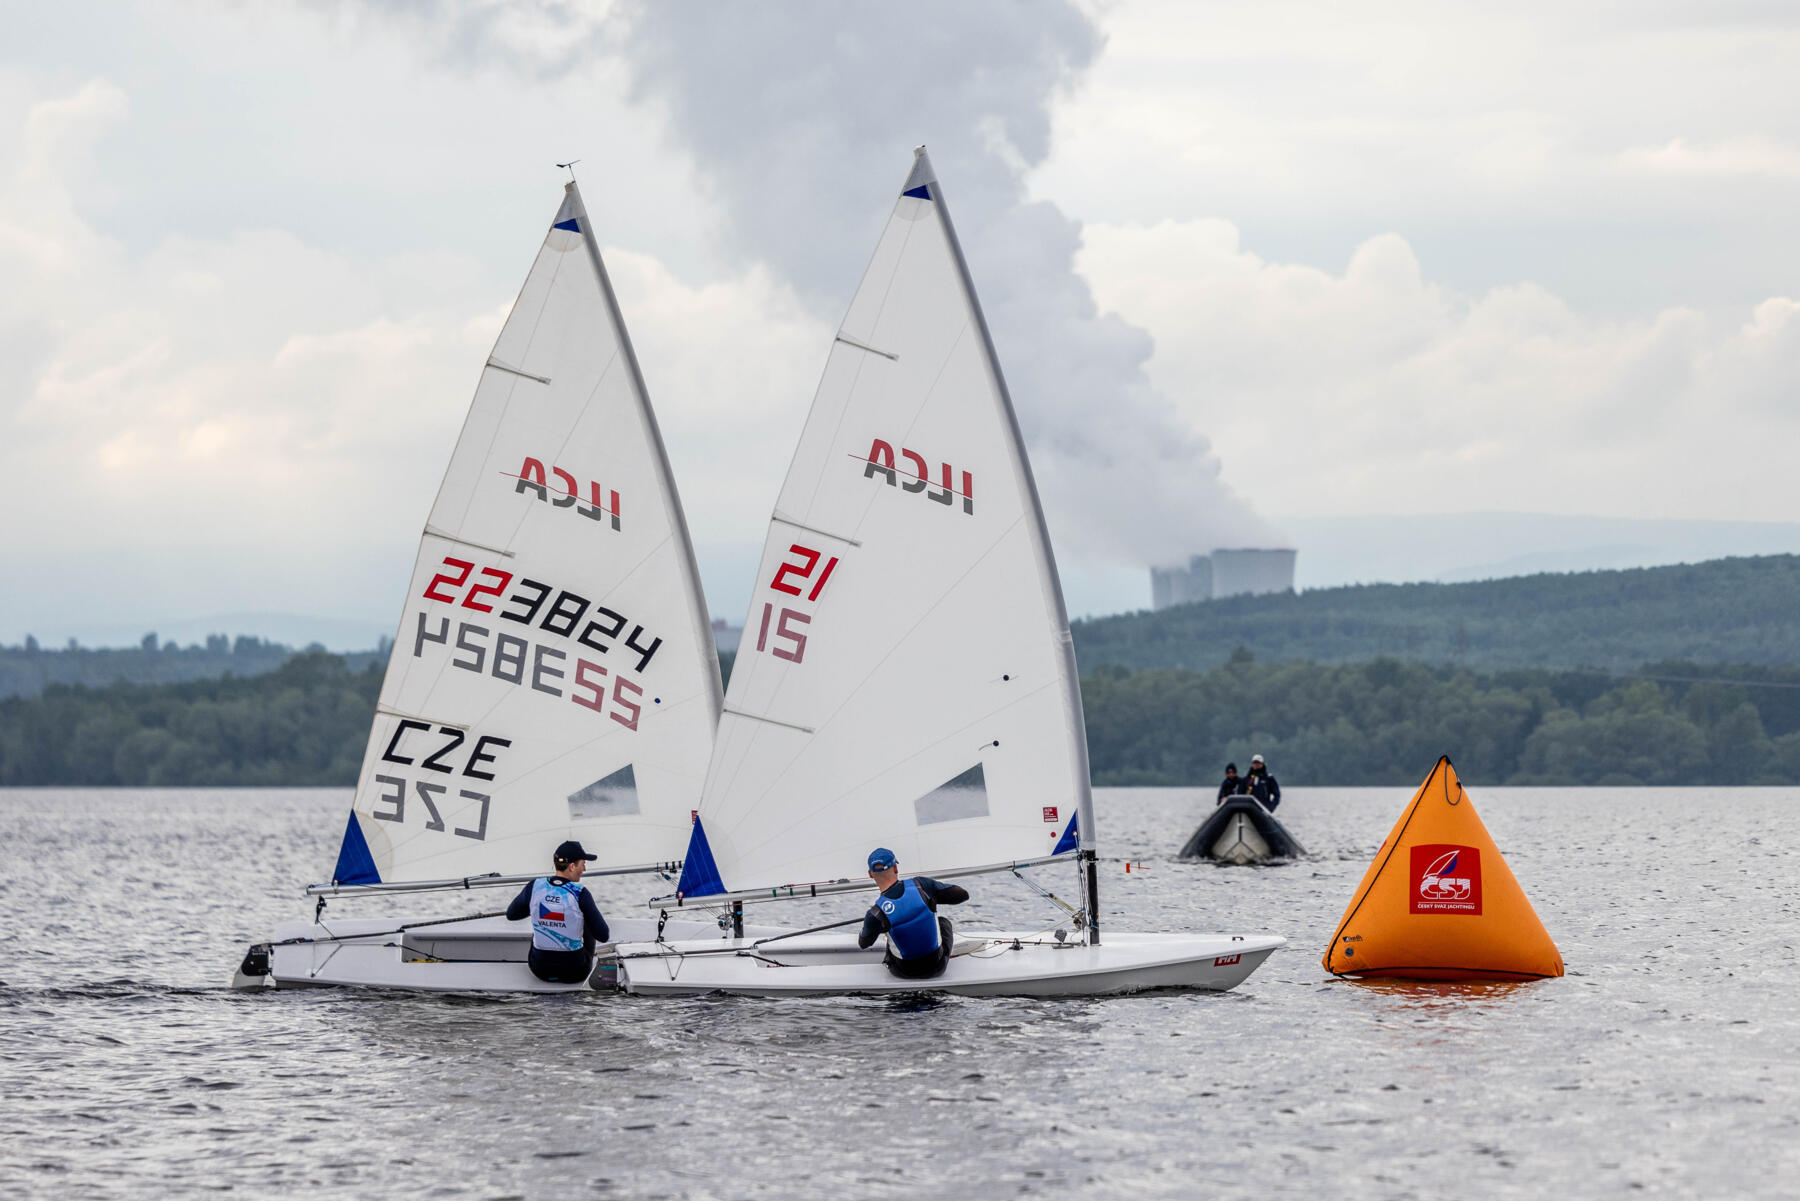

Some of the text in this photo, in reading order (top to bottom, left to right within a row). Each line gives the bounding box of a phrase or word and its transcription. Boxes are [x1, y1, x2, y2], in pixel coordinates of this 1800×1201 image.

[770, 544, 839, 602] 21
[423, 557, 663, 673] 223824
[382, 719, 512, 781] CZE
[538, 920, 567, 929] VALENTA
[545, 895, 560, 903] CZE
